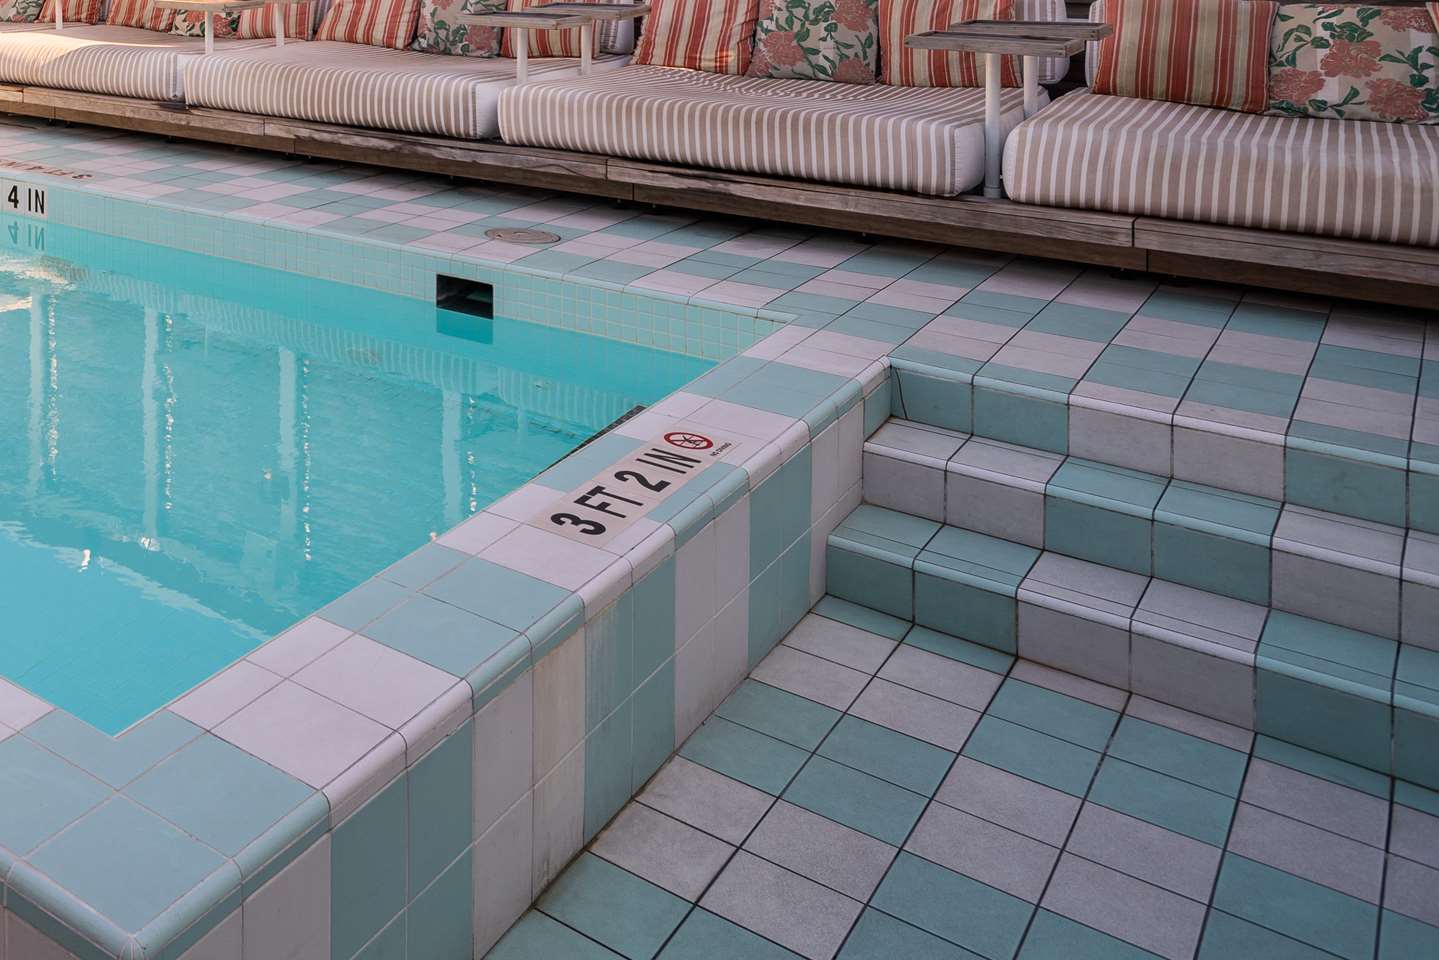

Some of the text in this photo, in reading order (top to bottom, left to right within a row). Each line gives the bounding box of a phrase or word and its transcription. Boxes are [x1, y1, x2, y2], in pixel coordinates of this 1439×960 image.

[7, 185, 19, 208] 4
[28, 187, 45, 214] IN
[550, 447, 702, 536] 3 FT 2 IN
